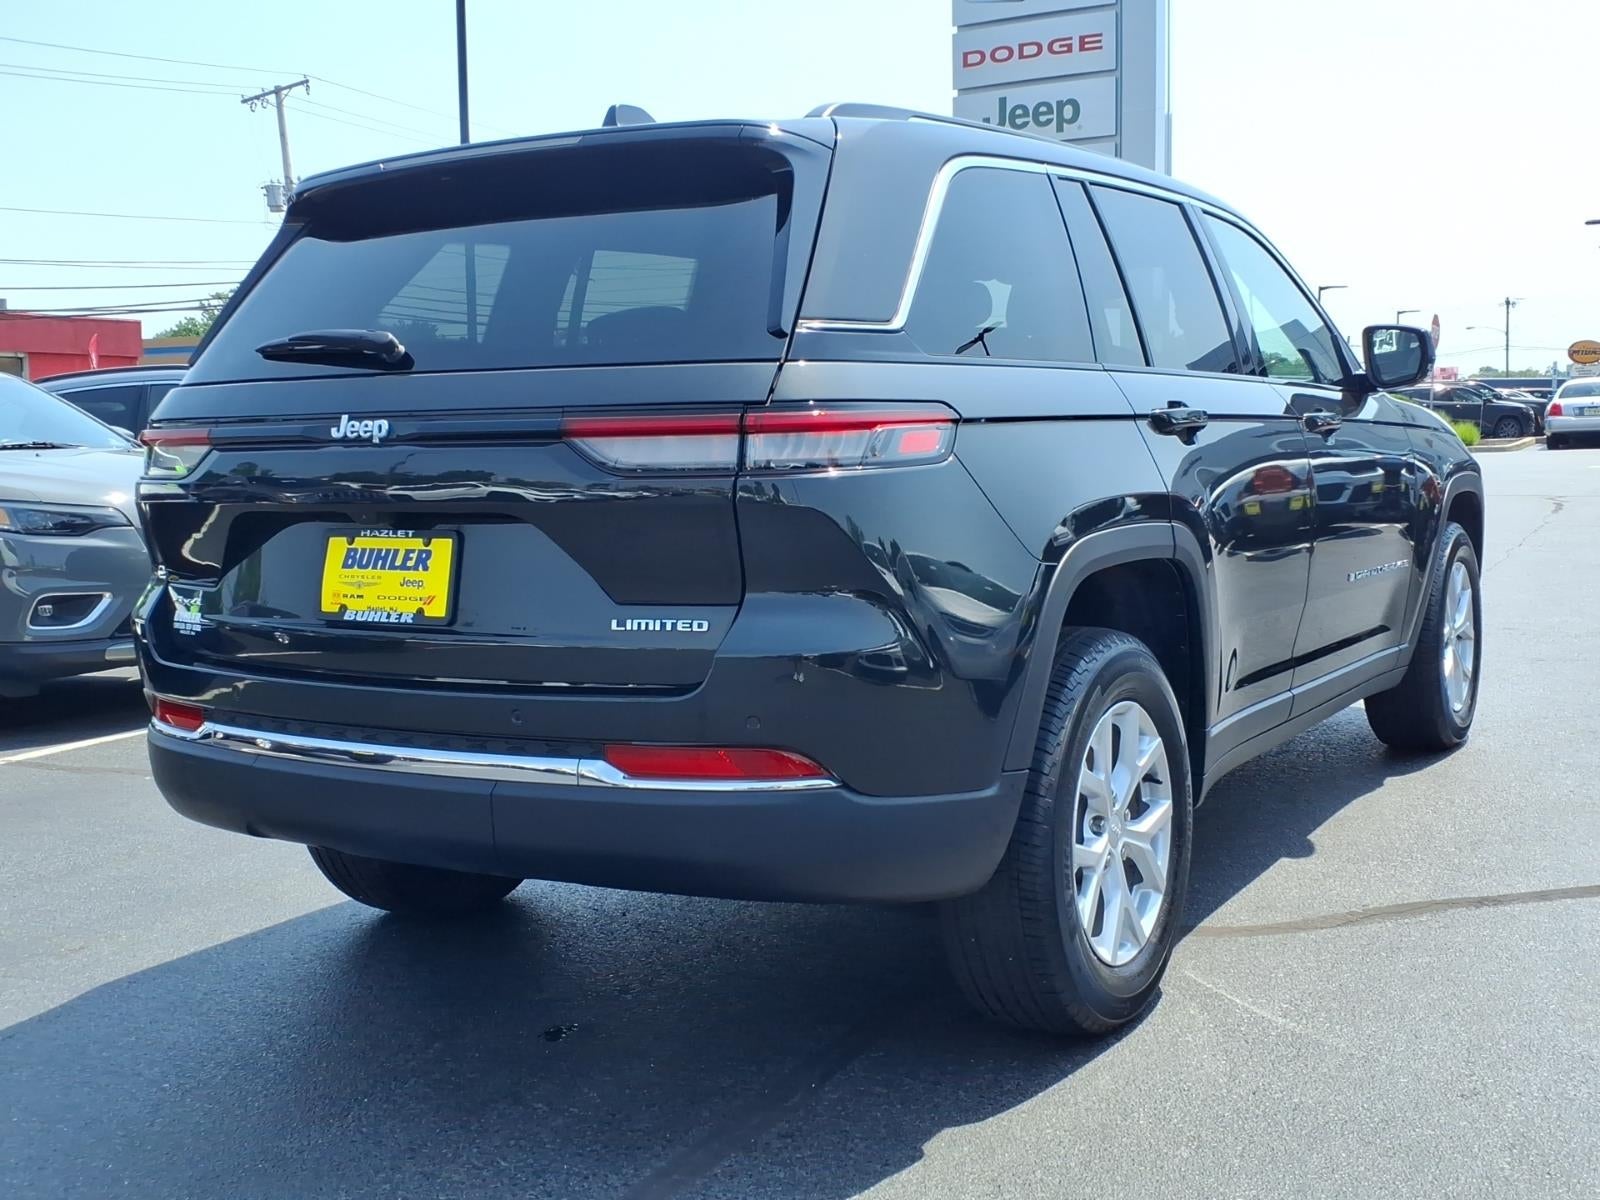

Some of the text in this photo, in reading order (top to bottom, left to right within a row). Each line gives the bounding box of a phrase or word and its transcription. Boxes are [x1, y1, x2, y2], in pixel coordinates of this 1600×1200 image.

[962, 32, 1104, 68] DODGE
[982, 96, 1081, 133] Jeep
[330, 414, 389, 444] Jeep
[360, 529, 416, 538] HAZLET
[342, 548, 432, 571] BUHLER
[399, 576, 424, 589] Jeep
[343, 609, 414, 623] BUHLER
[610, 619, 709, 632] LIMITED
